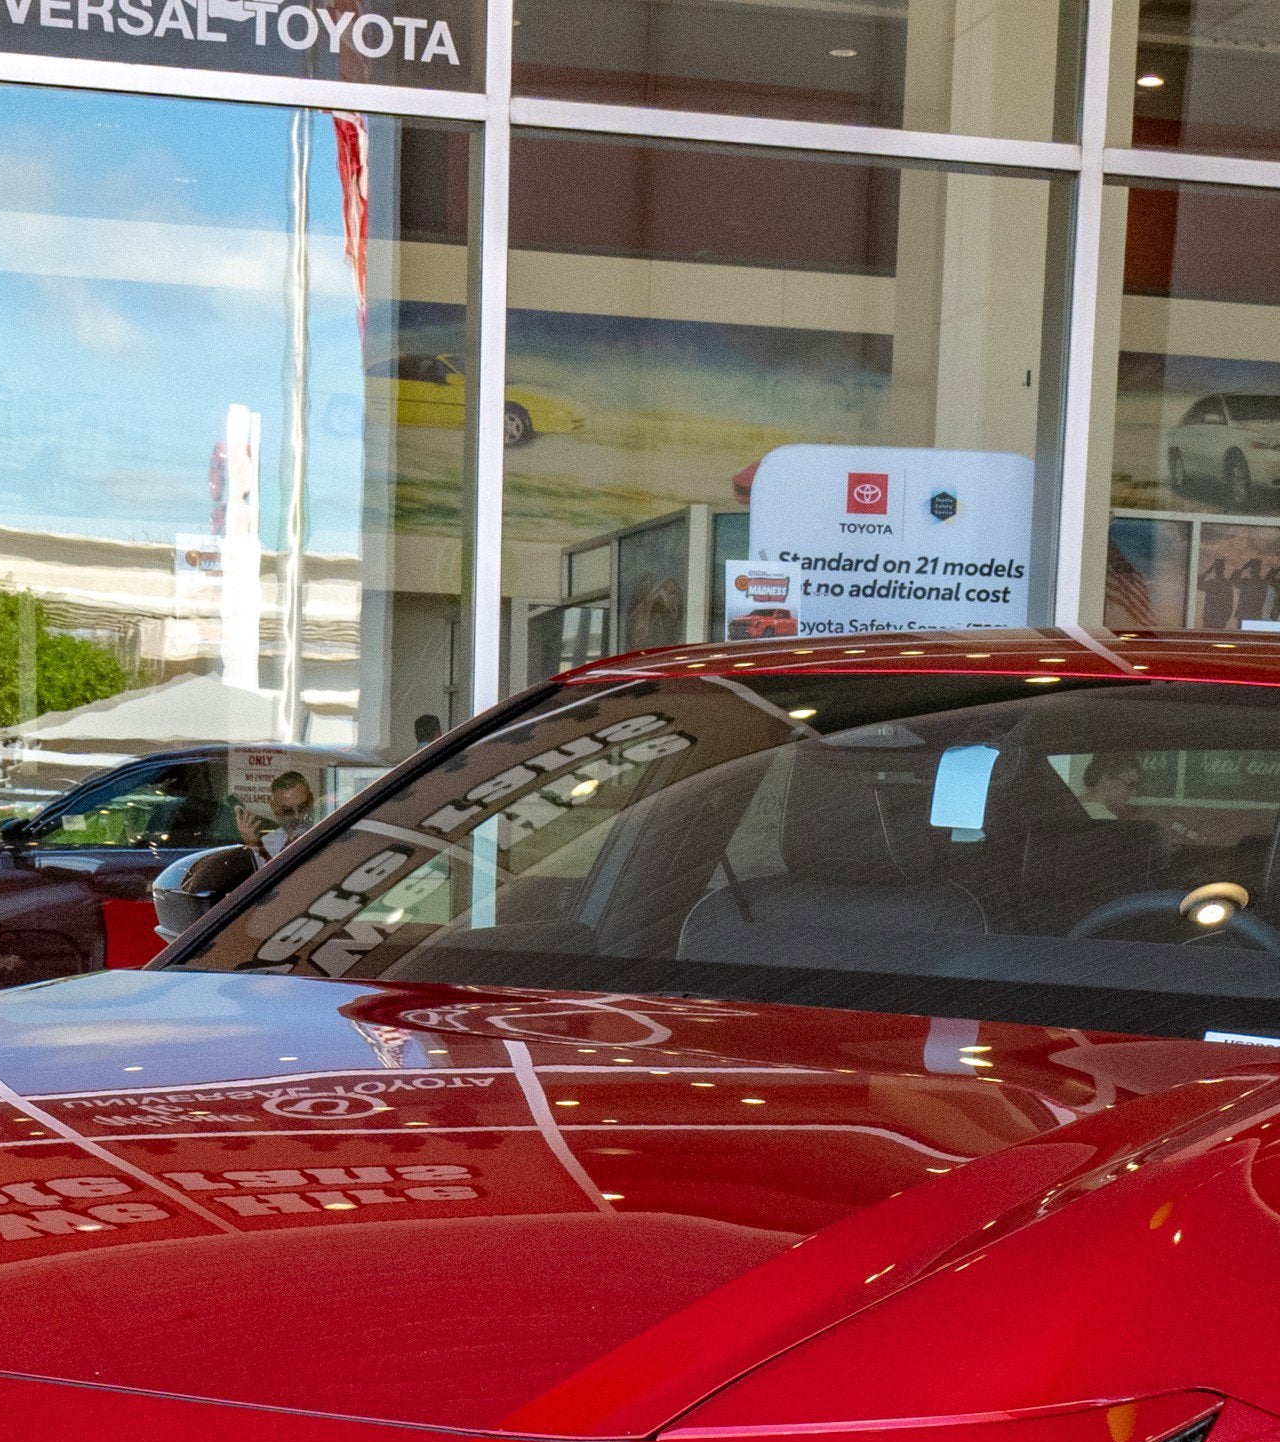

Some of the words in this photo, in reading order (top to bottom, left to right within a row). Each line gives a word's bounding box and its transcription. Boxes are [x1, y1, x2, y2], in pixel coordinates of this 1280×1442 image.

[243, 2, 461, 66] TOYOTA
[839, 523, 893, 535] TOYOTA
[778, 550, 880, 573] Standard
[882, 559, 911, 574] on
[915, 556, 939, 576] 21
[942, 559, 1025, 579] models
[816, 583, 845, 598] no
[848, 579, 961, 602] additional
[965, 586, 1011, 604] cost
[800, 620, 845, 637] oyota
[248, 755, 273, 767] ONLY
